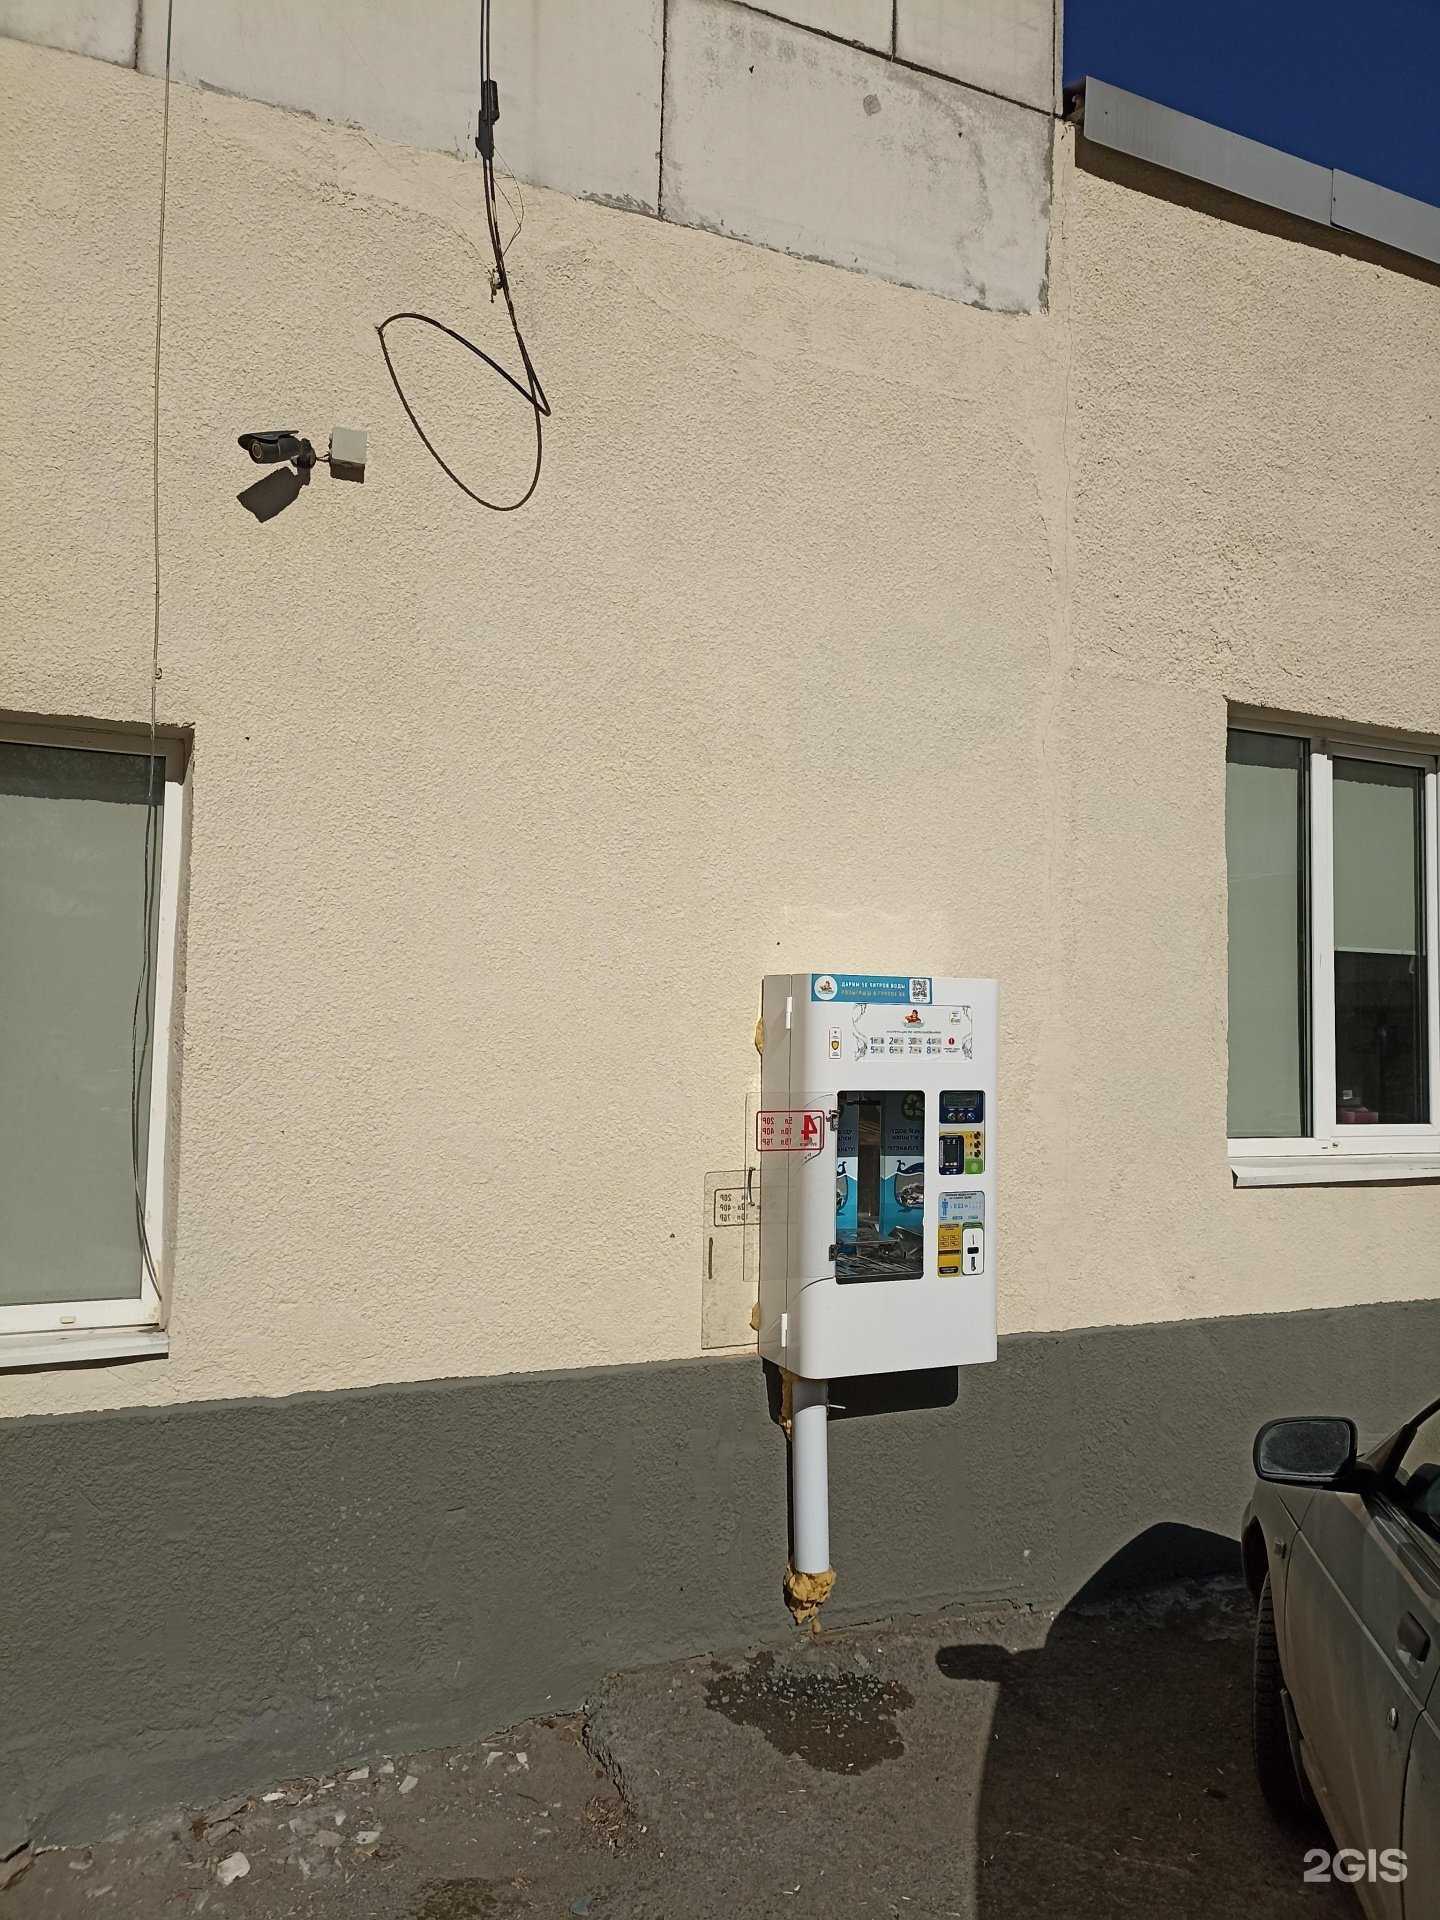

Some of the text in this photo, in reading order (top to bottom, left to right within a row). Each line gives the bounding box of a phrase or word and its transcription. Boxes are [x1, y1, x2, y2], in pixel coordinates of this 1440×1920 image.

[870, 1037, 874, 1045] 1
[889, 1037, 894, 1045] 2
[908, 1037, 913, 1045] 3
[926, 1037, 932, 1045] 4
[870, 1046, 875, 1054] 5
[889, 1046, 894, 1054] 6
[908, 1046, 913, 1054] 7
[926, 1046, 932, 1054] 8
